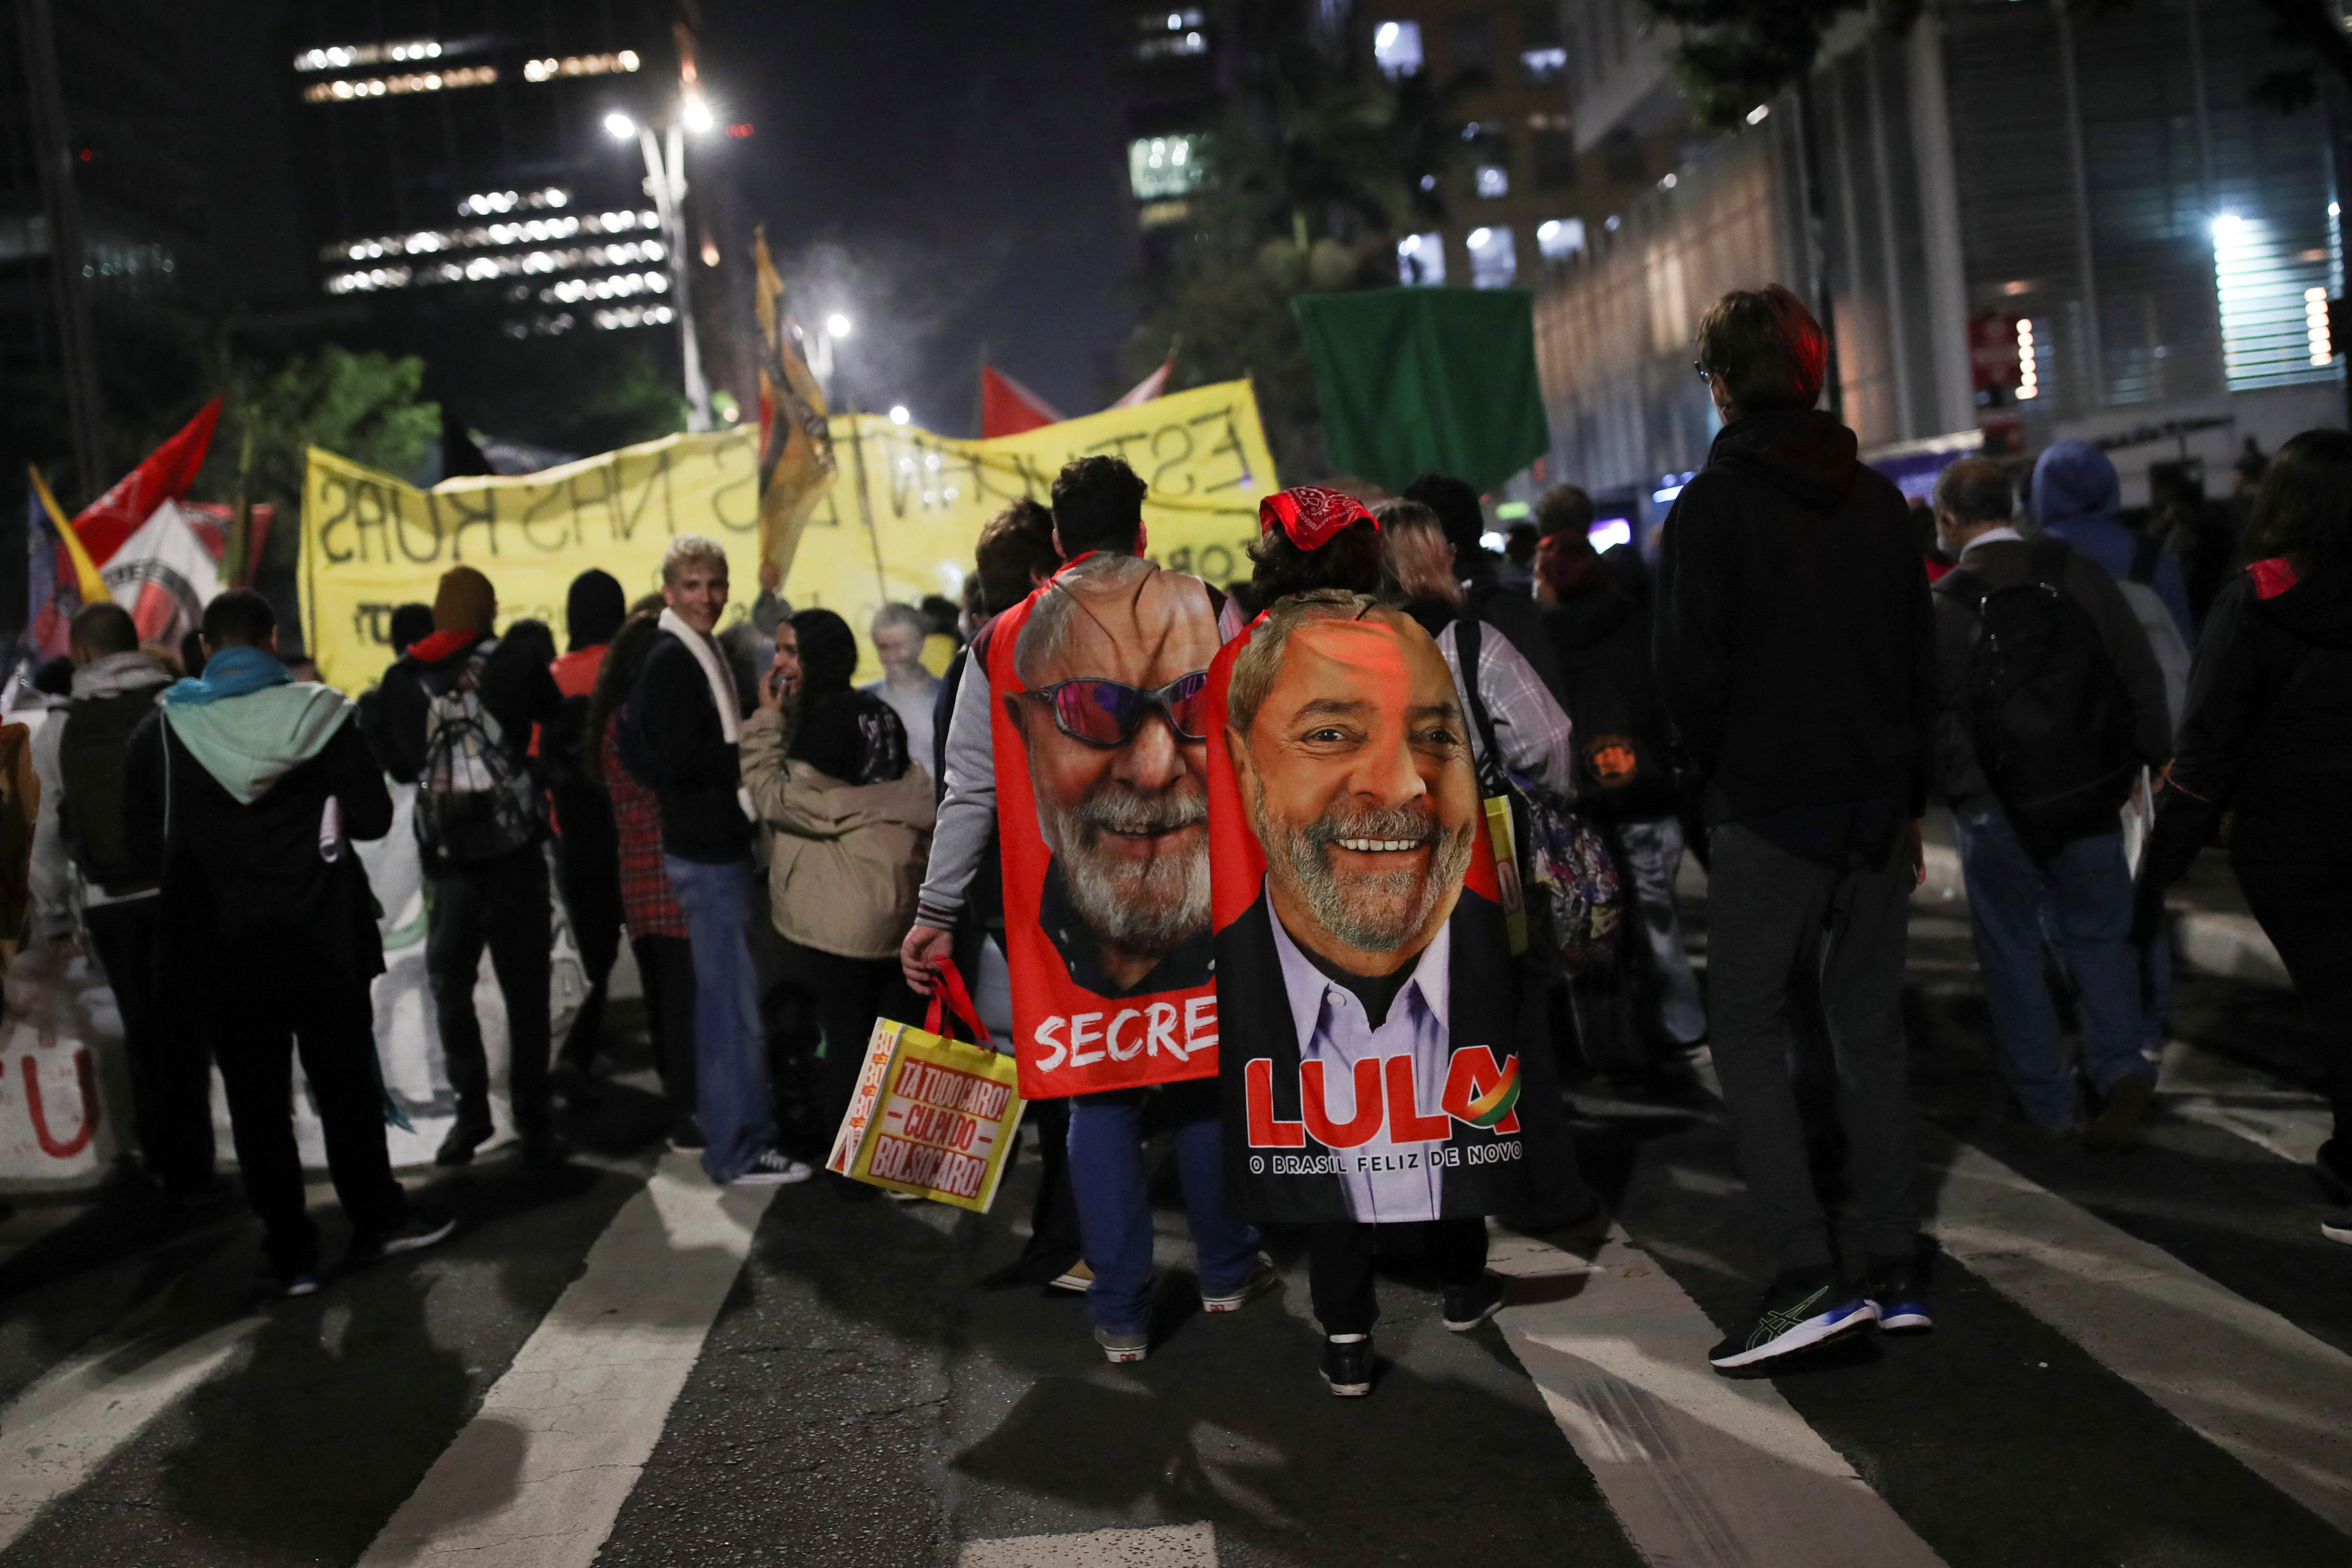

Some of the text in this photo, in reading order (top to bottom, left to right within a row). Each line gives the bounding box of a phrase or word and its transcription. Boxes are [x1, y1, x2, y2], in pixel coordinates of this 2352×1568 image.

[1034, 994, 1219, 1074] SECRE
[897, 1061, 1012, 1121] TÁ TUDO CARO!
[1244, 1045, 1521, 1149] LULA
[903, 1104, 977, 1152] CULPA DO
[1249, 1141, 1523, 1175] O BRASIL FELIZ DE NOVO
[870, 1135, 987, 1198] BOLSOCARO!
